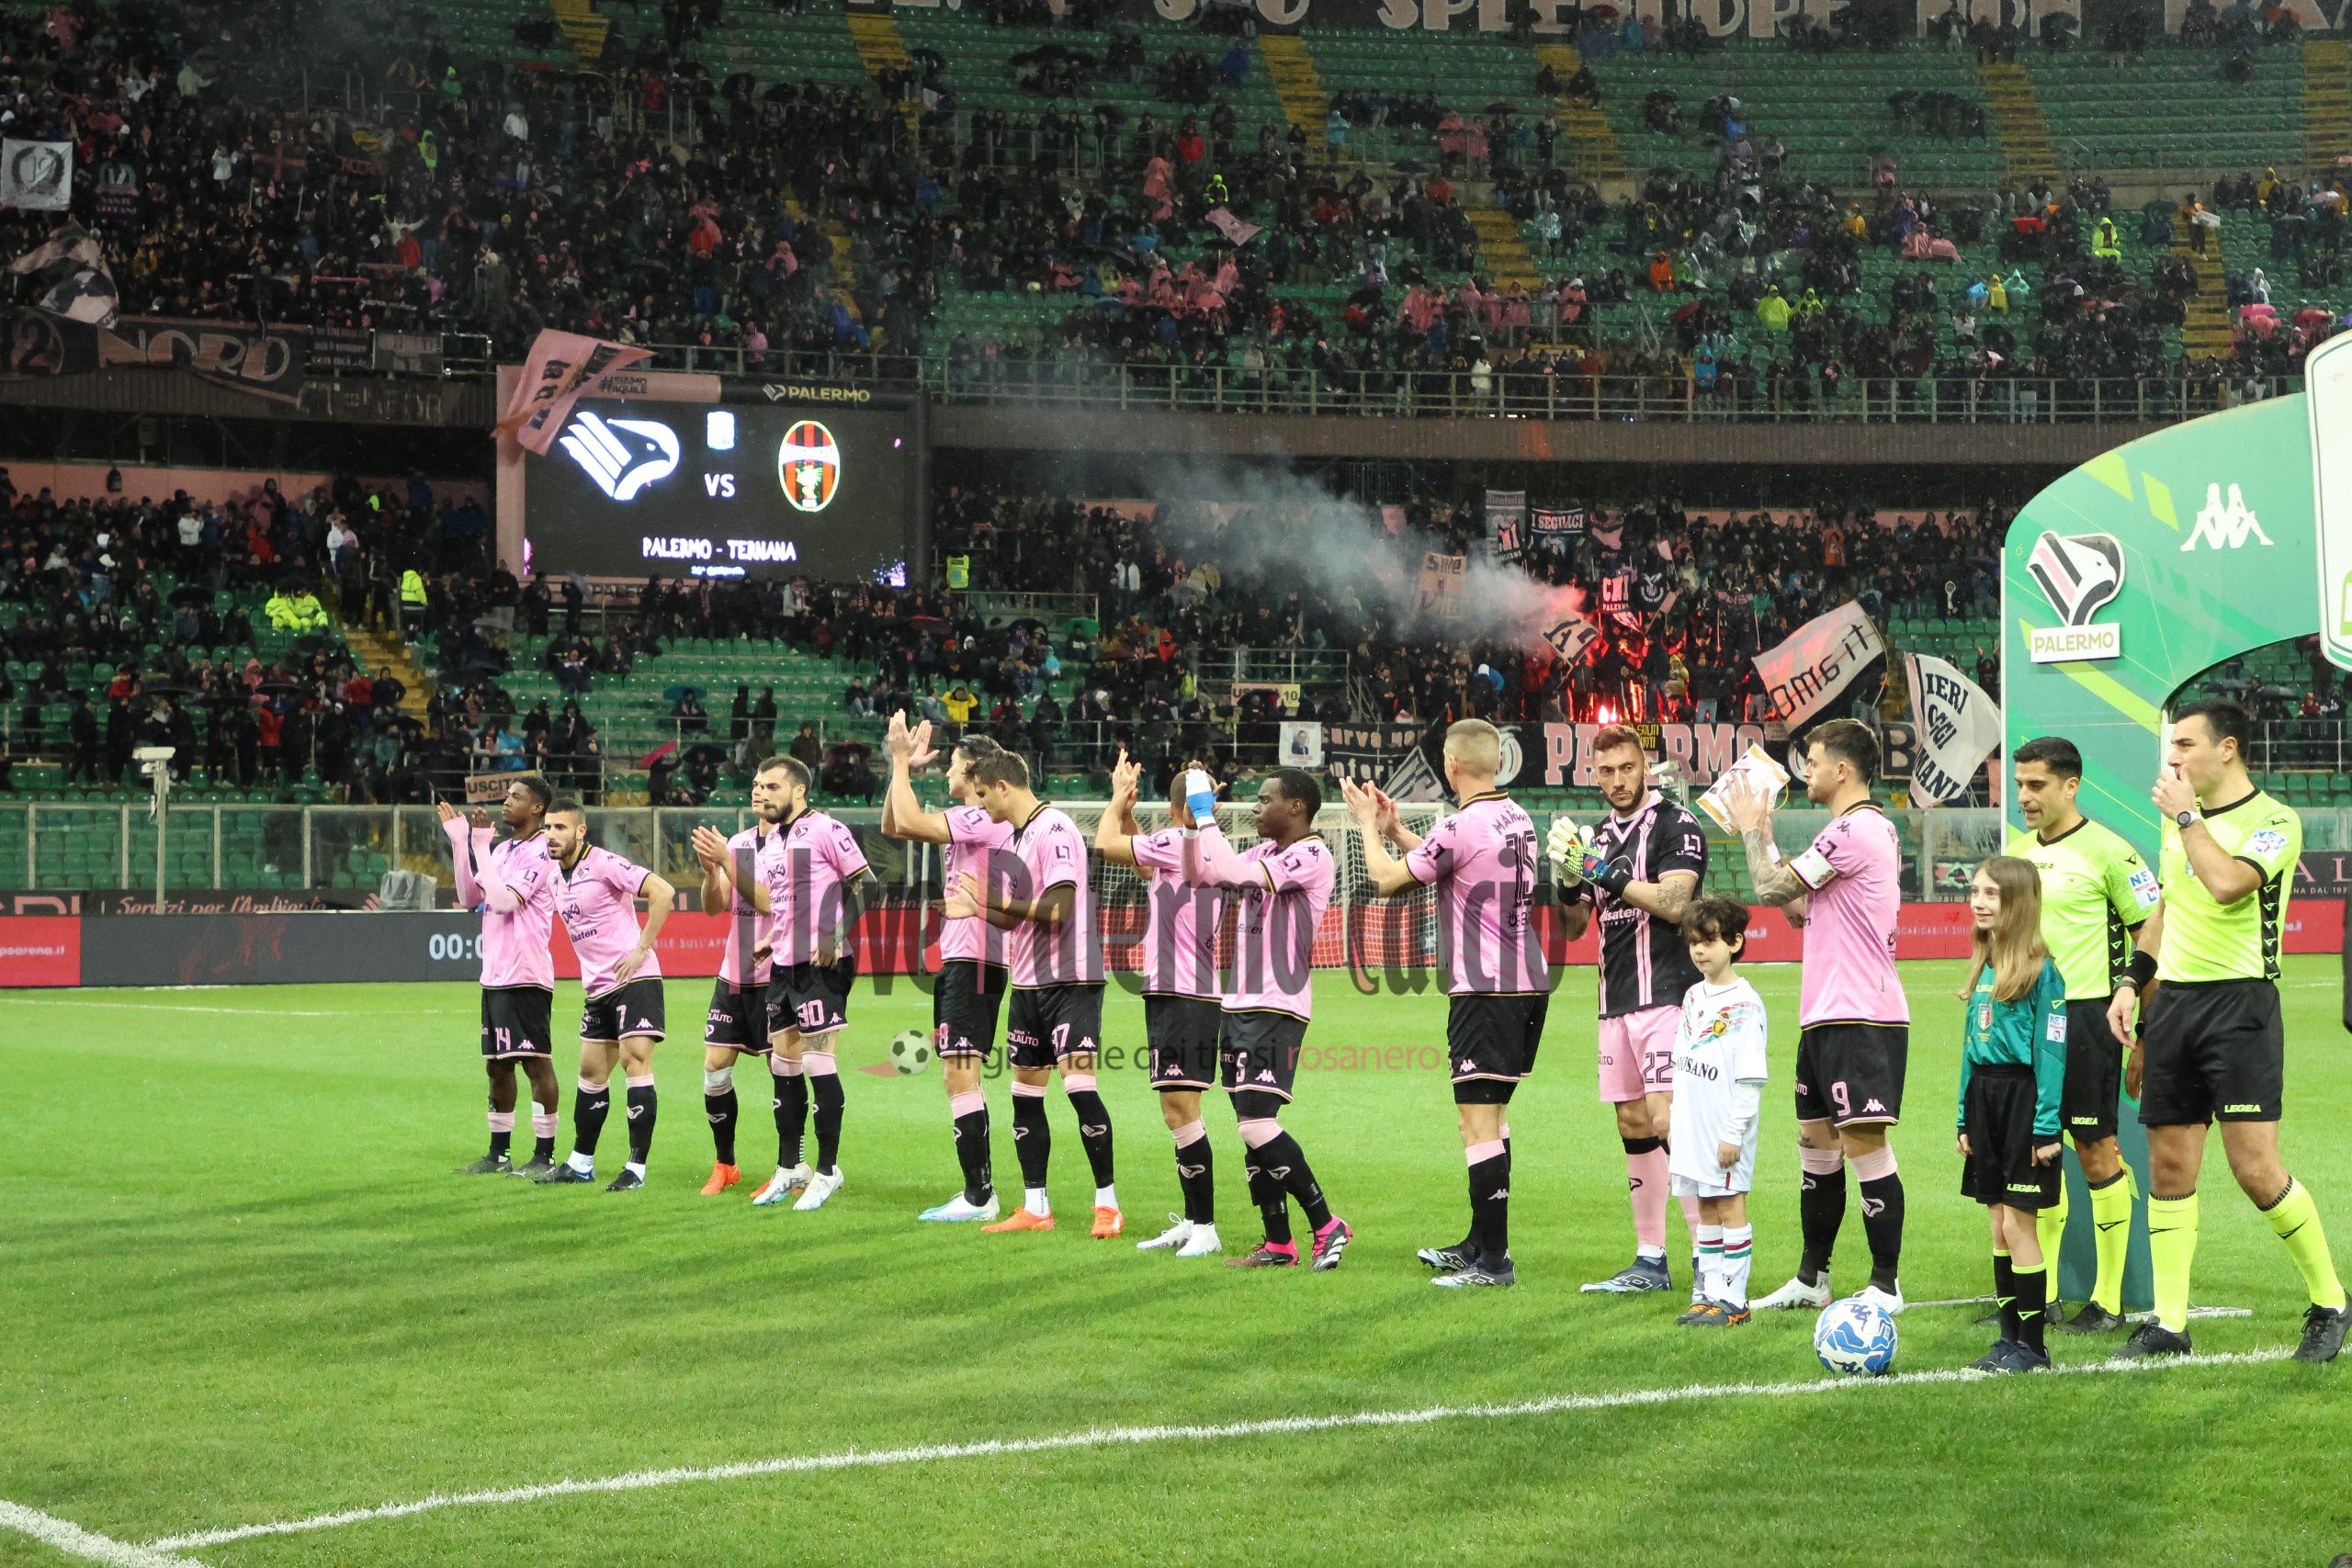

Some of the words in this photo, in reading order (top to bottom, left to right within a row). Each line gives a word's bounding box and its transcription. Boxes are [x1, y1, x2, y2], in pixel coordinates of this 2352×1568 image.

[98, 328, 290, 381] NORD
[788, 386, 871, 403] PALERMO
[704, 473, 736, 497] VS
[1538, 513, 1584, 530] SEGUACI
[642, 536, 712, 560] PALERMO
[727, 539, 797, 561] TERNANA
[2033, 631, 2114, 654] PALERMO
[1283, 691, 1298, 701] 10
[1925, 672, 1969, 715] IERI
[1928, 704, 1958, 750] OGGI
[1544, 723, 1765, 786] PARMO
[1916, 746, 1961, 800] MANI
[117, 896, 186, 914] Serizi
[733, 907, 761, 918] Bisat
[616, 1004, 628, 1030] 7
[796, 999, 825, 1028] 30
[494, 1027, 512, 1051] 14
[1643, 1051, 1673, 1084] 22
[1831, 1080, 1851, 1117] 9
[2225, 1104, 2262, 1113] LEGEA
[2071, 1116, 2098, 1125] LEGEA
[2007, 1182, 2041, 1193] LEGEA
